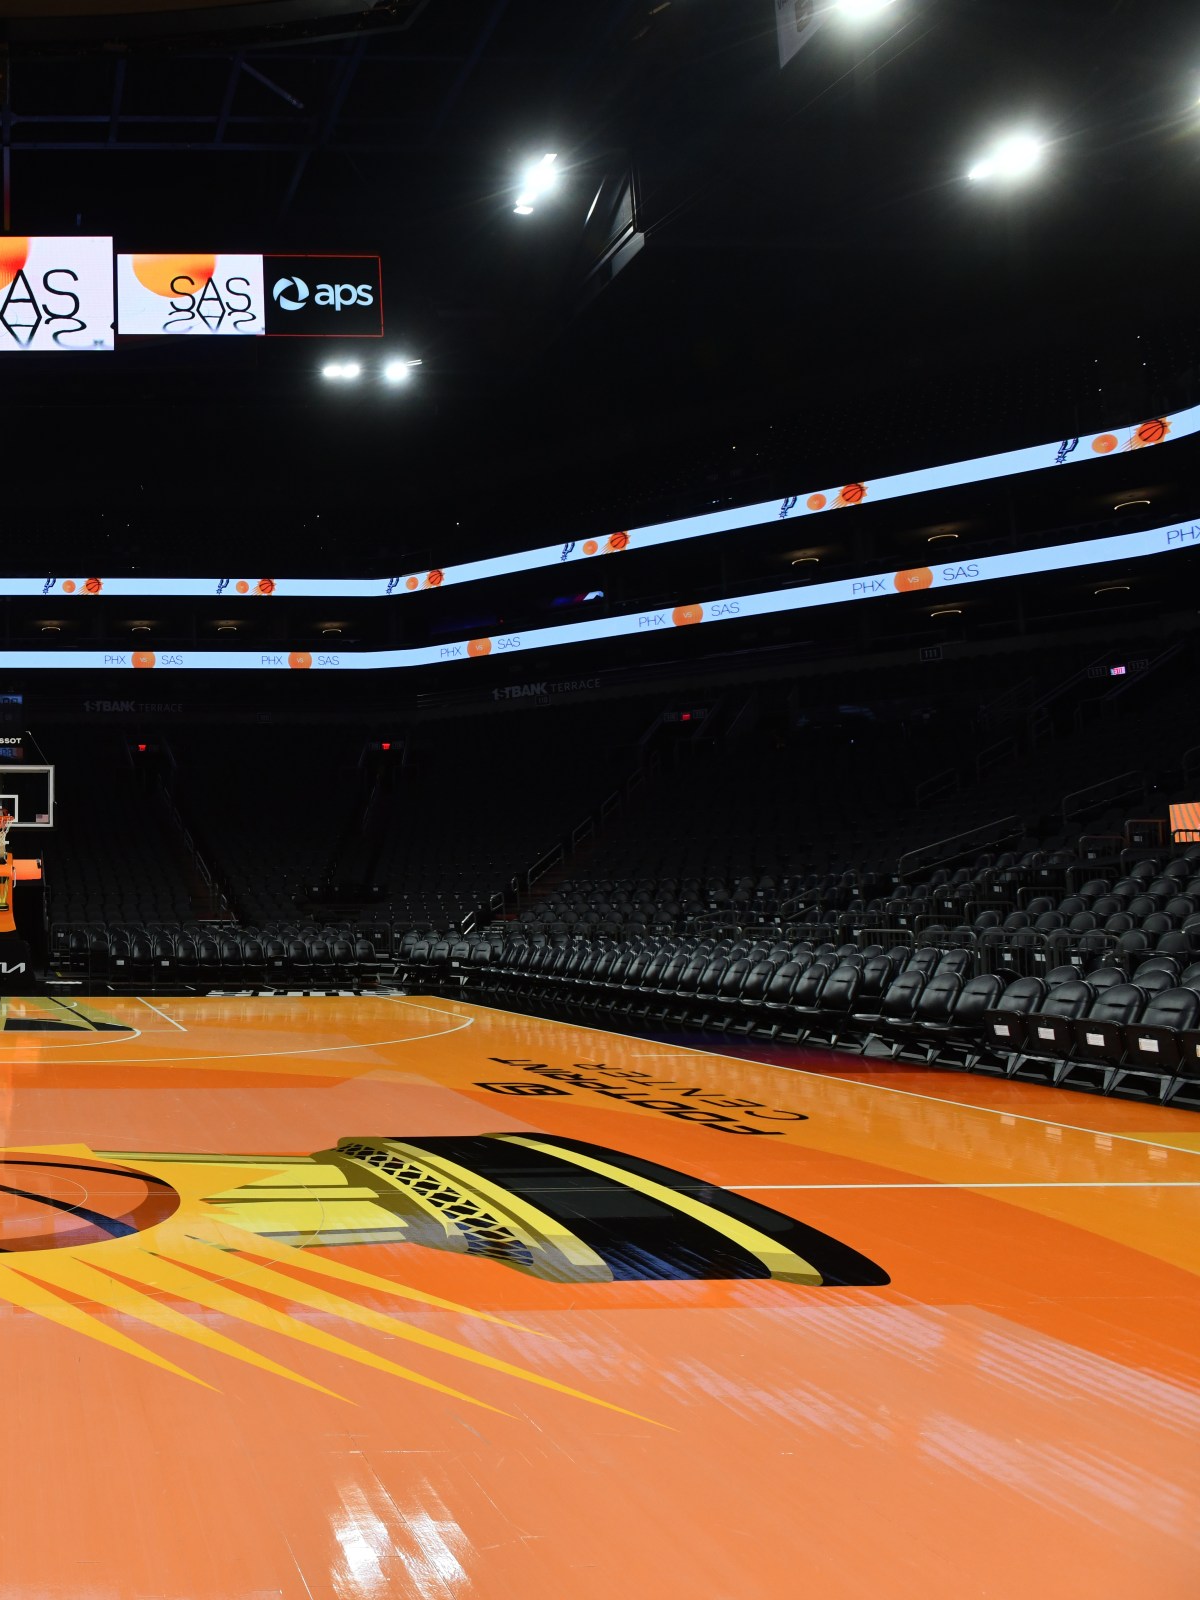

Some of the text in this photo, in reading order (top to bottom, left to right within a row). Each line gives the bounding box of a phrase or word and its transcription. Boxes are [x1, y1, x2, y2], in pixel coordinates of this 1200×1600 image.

[170, 276, 251, 312] SAS
[314, 283, 373, 311] aps
[852, 579, 886, 595] PHX
[943, 564, 979, 581] SAS
[638, 614, 665, 628] PHX
[711, 602, 740, 617] SAS
[104, 655, 126, 665] PHX
[161, 655, 183, 665] SAS
[440, 646, 462, 657] PHX
[497, 636, 521, 650] SAS
[261, 655, 282, 666] PHX
[317, 655, 340, 666] SAS
[550, 678, 601, 693] TERRACE
[488, 1057, 786, 1136] FOOTPRINT
[572, 1063, 810, 1121] CENTER
